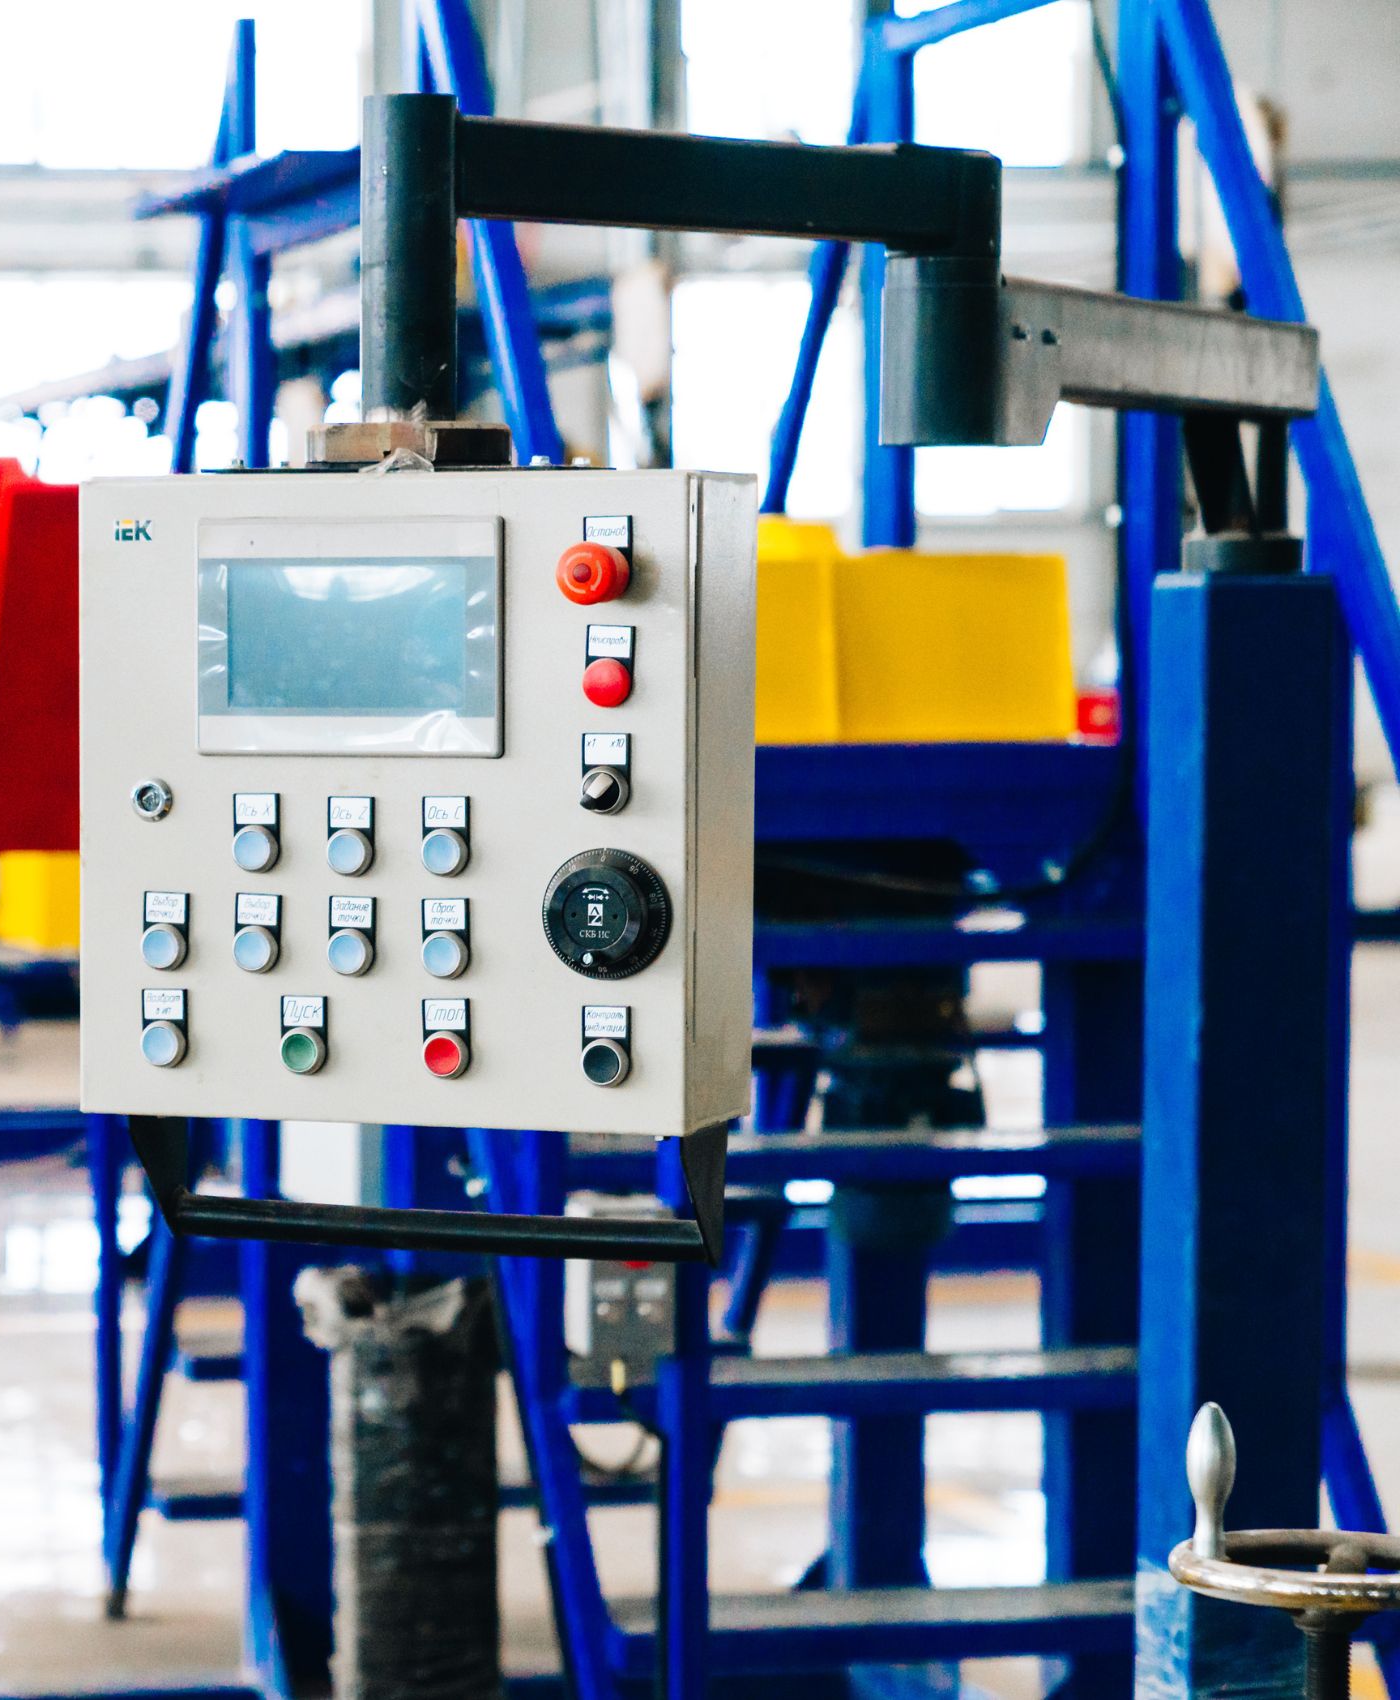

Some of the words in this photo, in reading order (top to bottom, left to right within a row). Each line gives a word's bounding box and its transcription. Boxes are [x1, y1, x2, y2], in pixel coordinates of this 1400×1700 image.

[586, 525, 626, 538] Останов
[238, 802, 258, 817] Ось
[332, 806, 352, 820] Ось
[358, 806, 369, 820] Z
[428, 805, 449, 820] Ось
[334, 900, 370, 912] Задание
[431, 902, 456, 915] Сброс
[337, 914, 366, 923] точки
[430, 917, 459, 925] точки
[579, 930, 596, 938] СКБ
[283, 1000, 322, 1023] Пуск
[426, 1004, 465, 1022] Стоп
